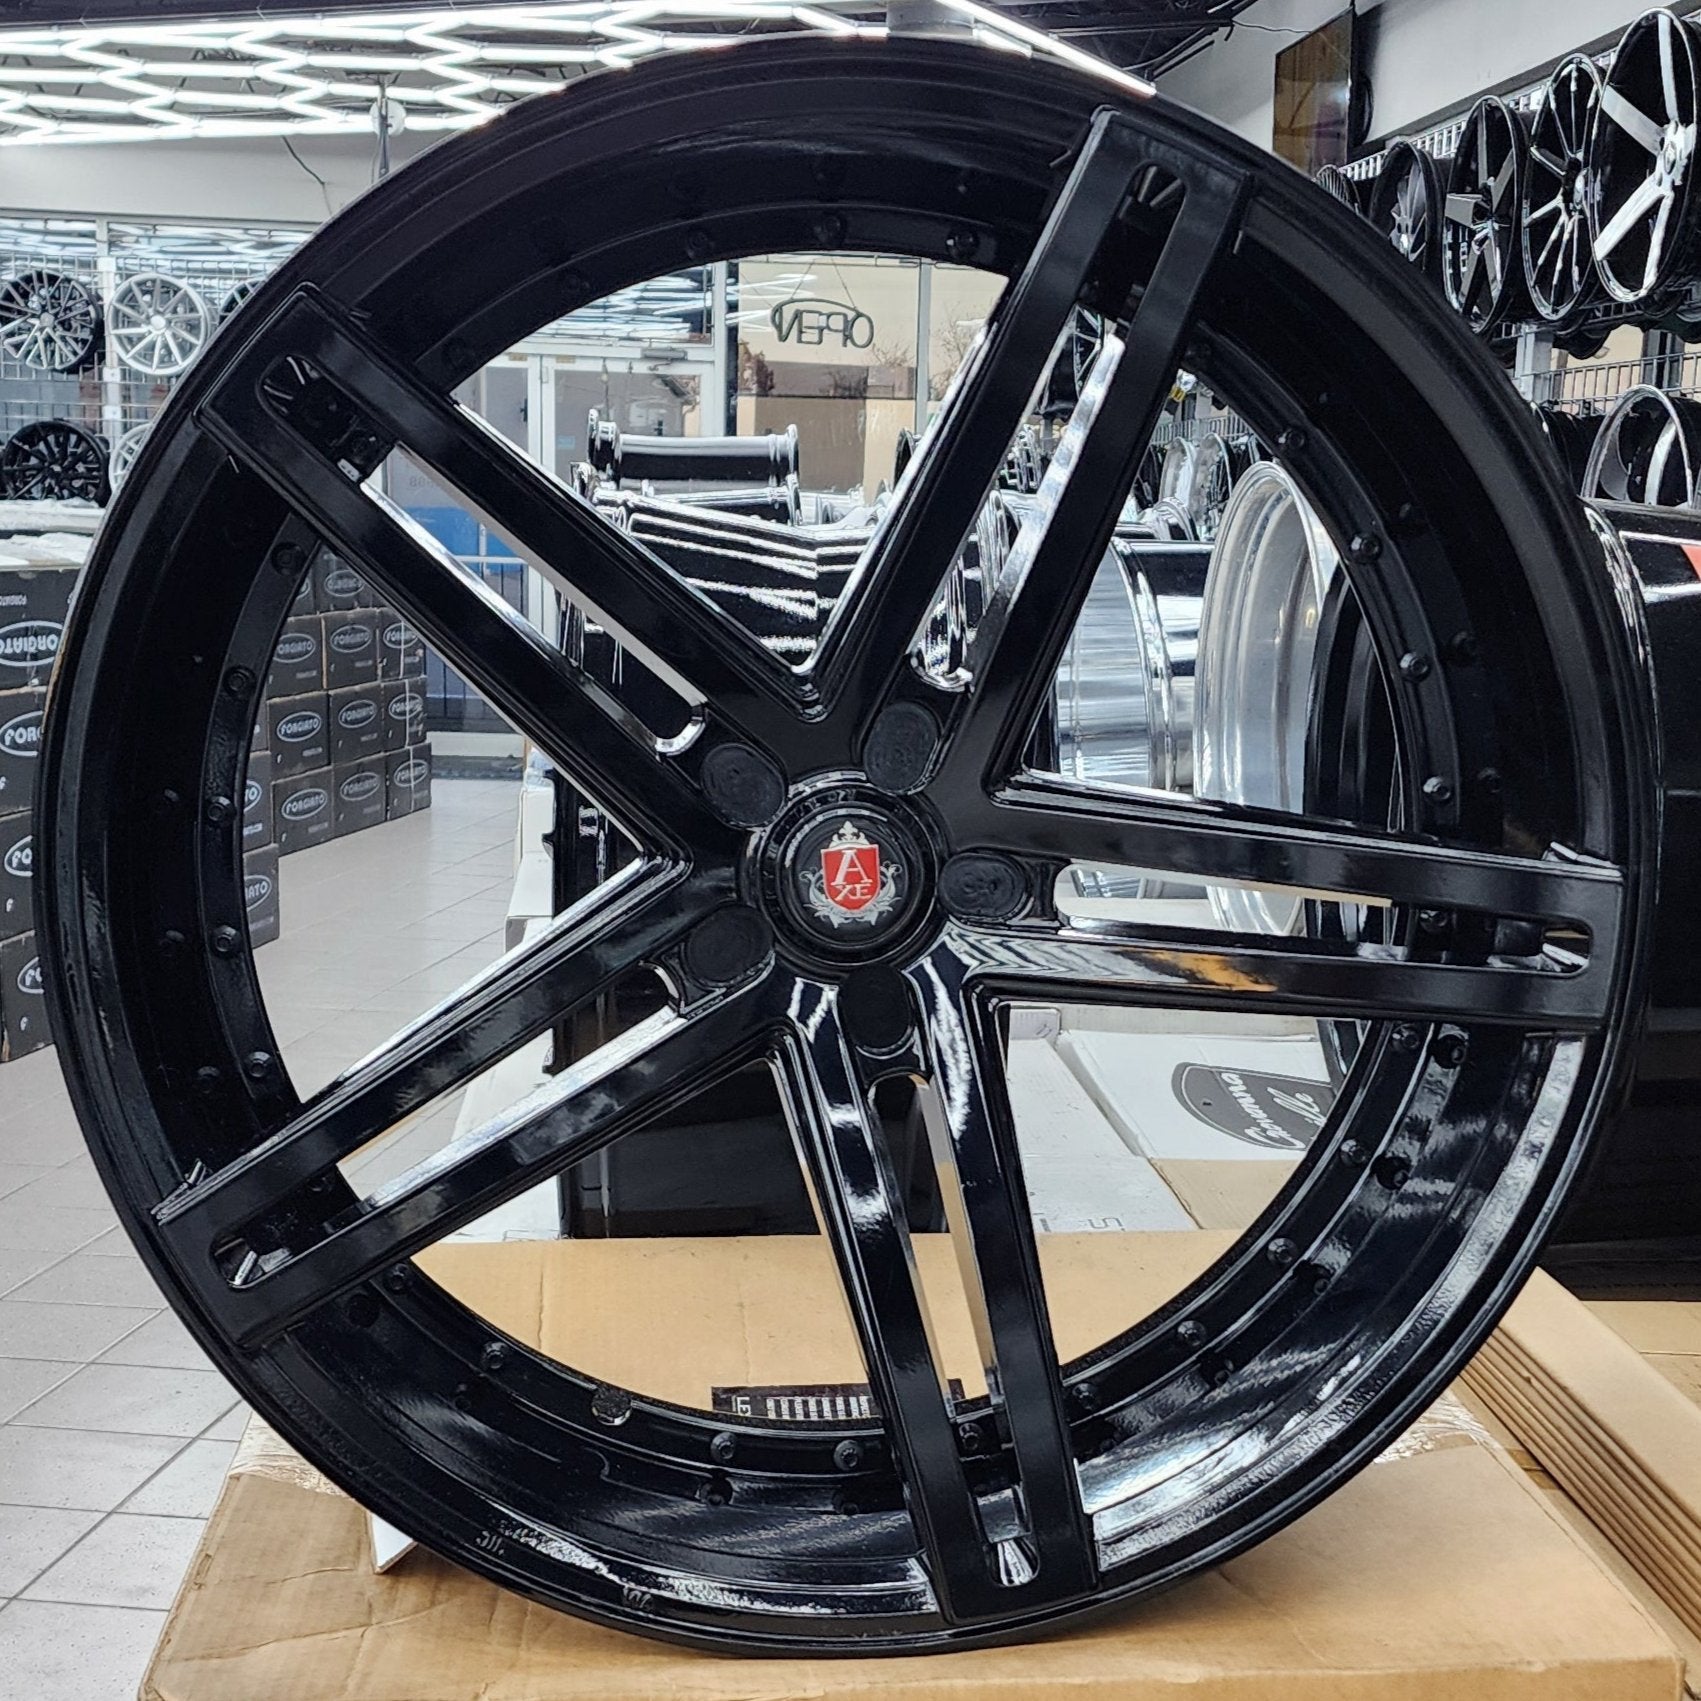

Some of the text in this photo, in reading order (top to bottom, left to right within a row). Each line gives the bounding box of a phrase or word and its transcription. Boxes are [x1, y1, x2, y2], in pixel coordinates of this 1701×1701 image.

[0, 634, 58, 653] ORGIAT
[278, 641, 313, 655] ORGIATO
[1267, 1086, 1327, 1126] ille
